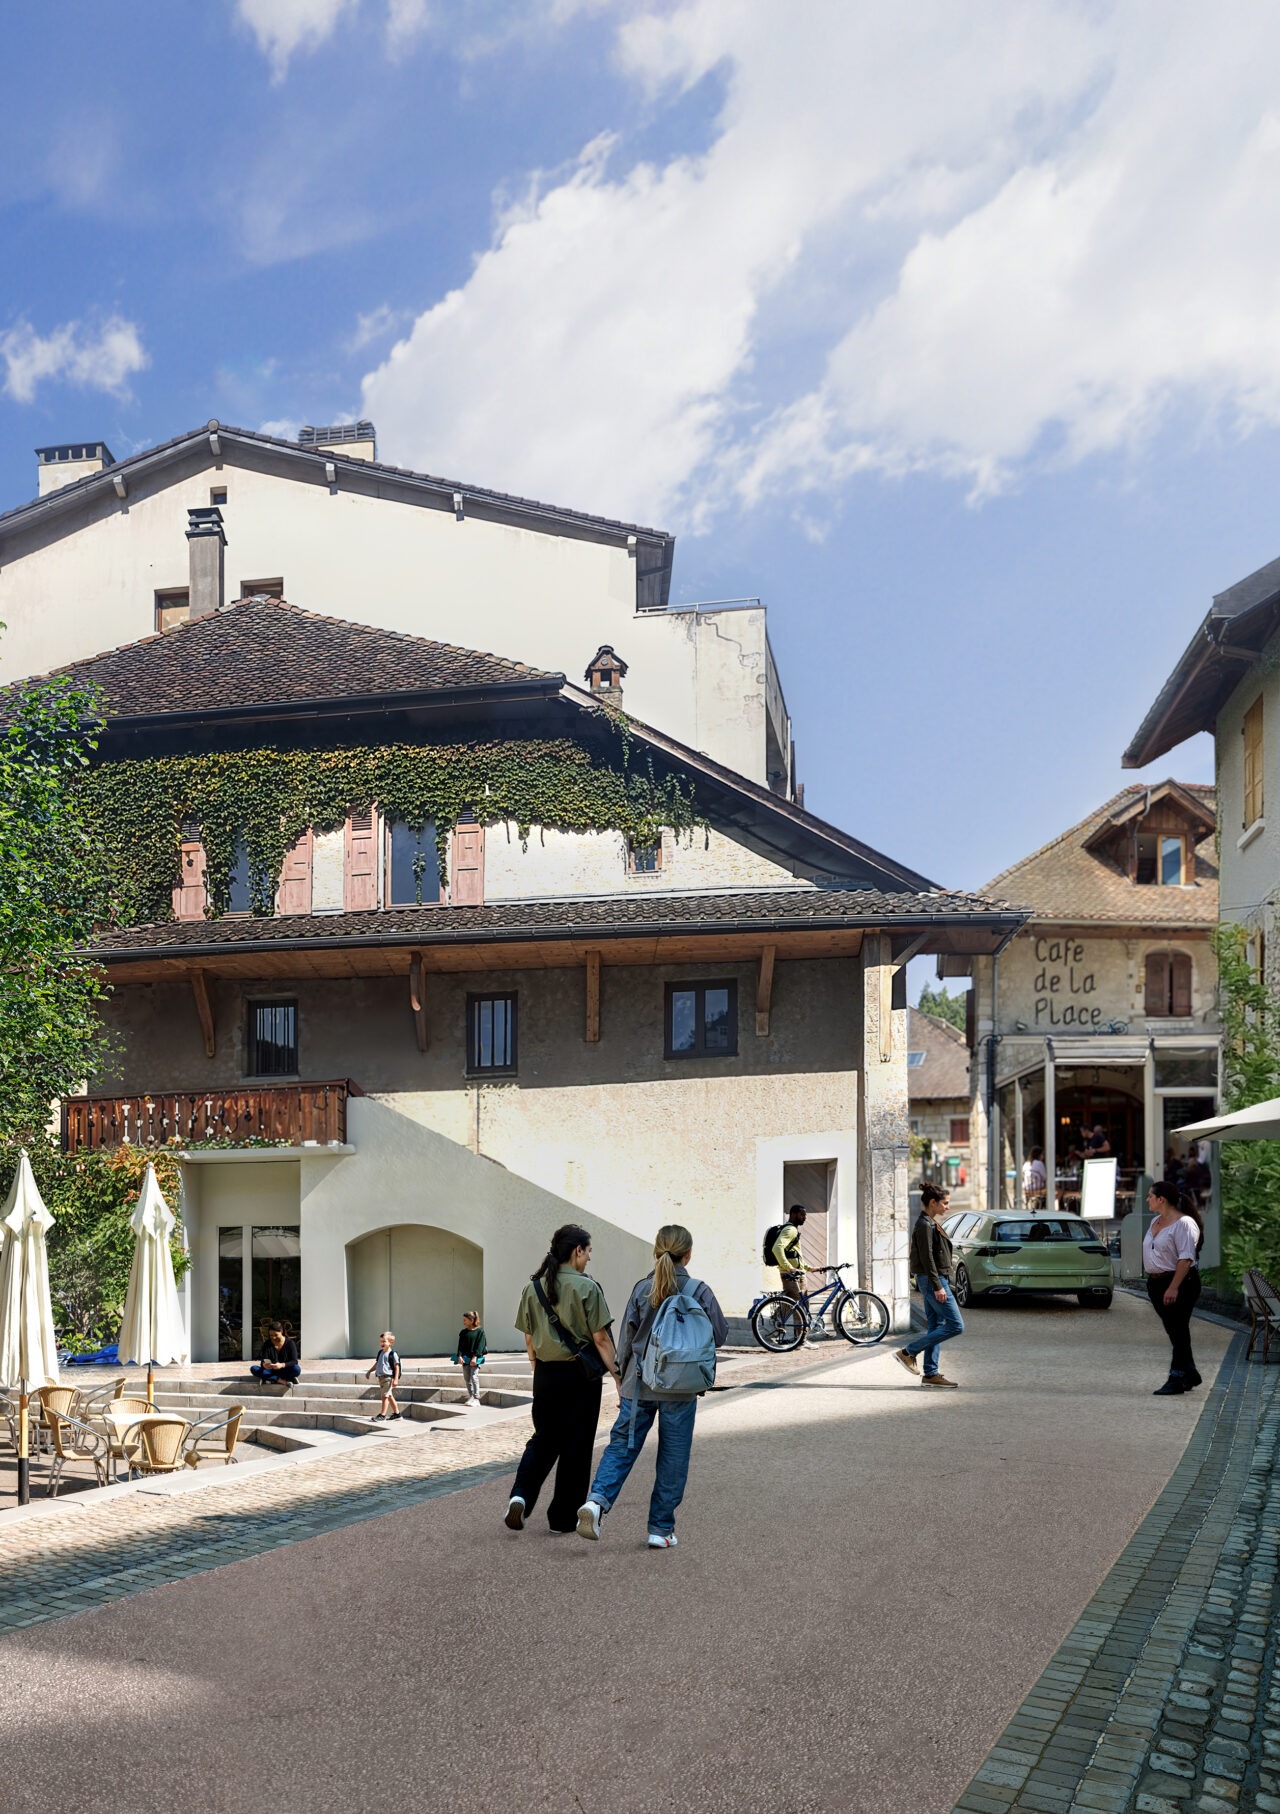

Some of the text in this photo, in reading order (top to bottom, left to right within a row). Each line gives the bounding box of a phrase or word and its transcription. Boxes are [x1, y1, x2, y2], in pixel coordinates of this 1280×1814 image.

[1035, 937, 1084, 966] Cafe
[1034, 966, 1096, 993] de la
[1035, 998, 1101, 1025] Place
